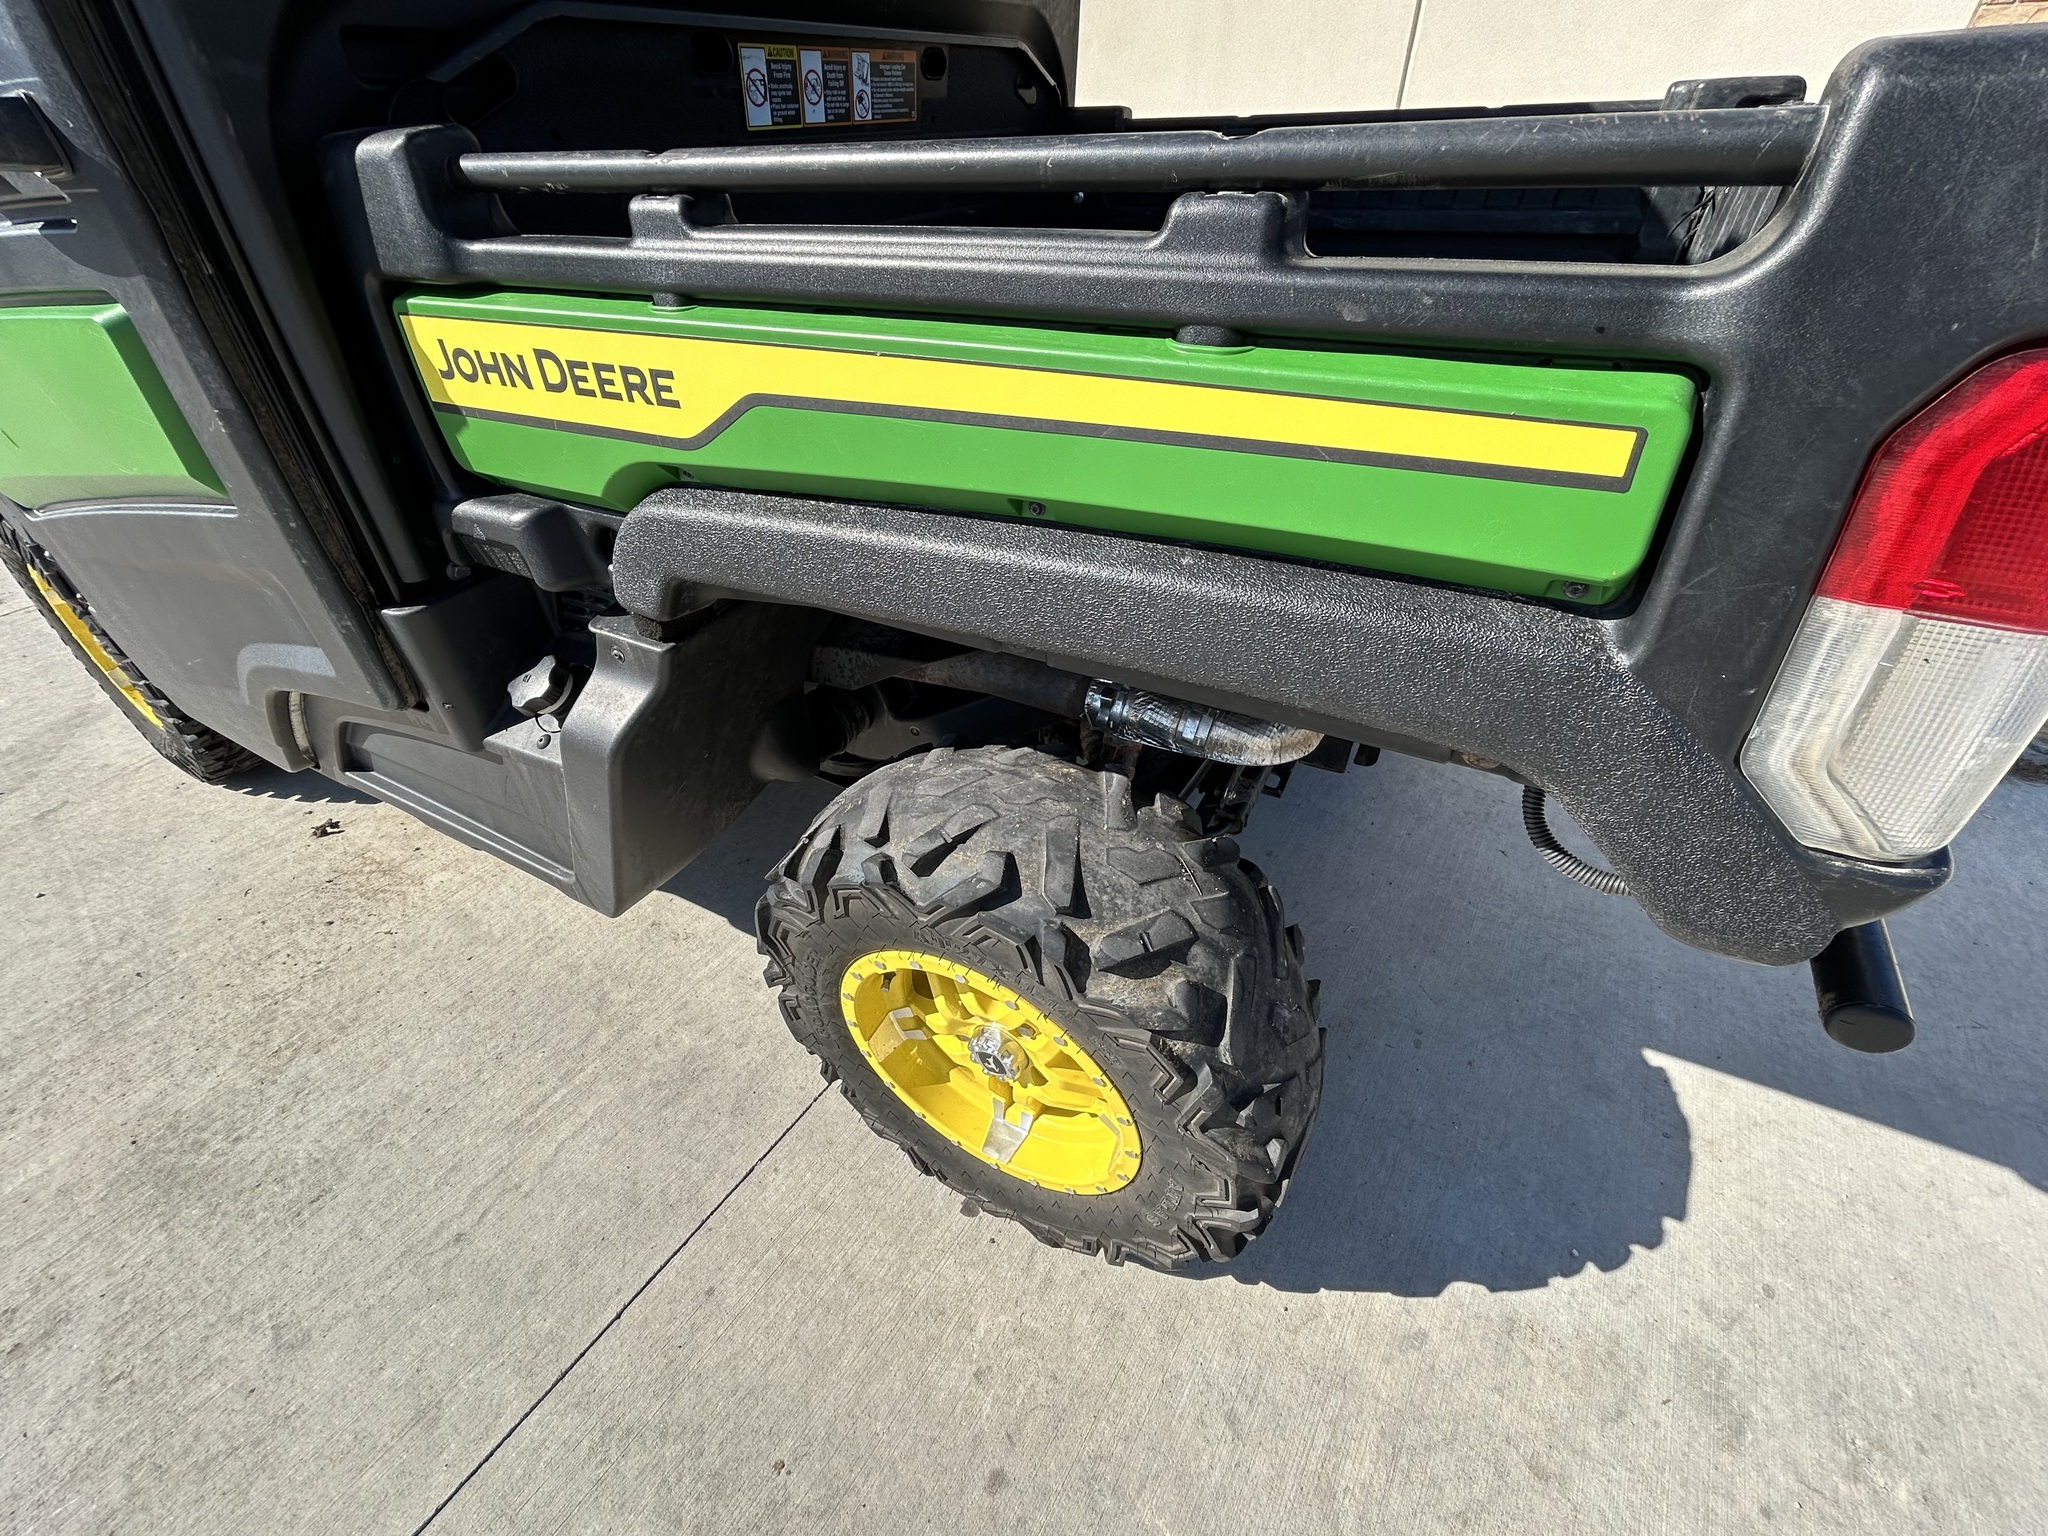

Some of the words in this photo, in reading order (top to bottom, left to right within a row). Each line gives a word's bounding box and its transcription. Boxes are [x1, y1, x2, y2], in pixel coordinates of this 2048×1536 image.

[773, 46, 795, 58] CAUTION
[436, 338, 534, 390] JOHN
[532, 348, 682, 409] DEERE
[1145, 1176, 1185, 1228] ATLAS
